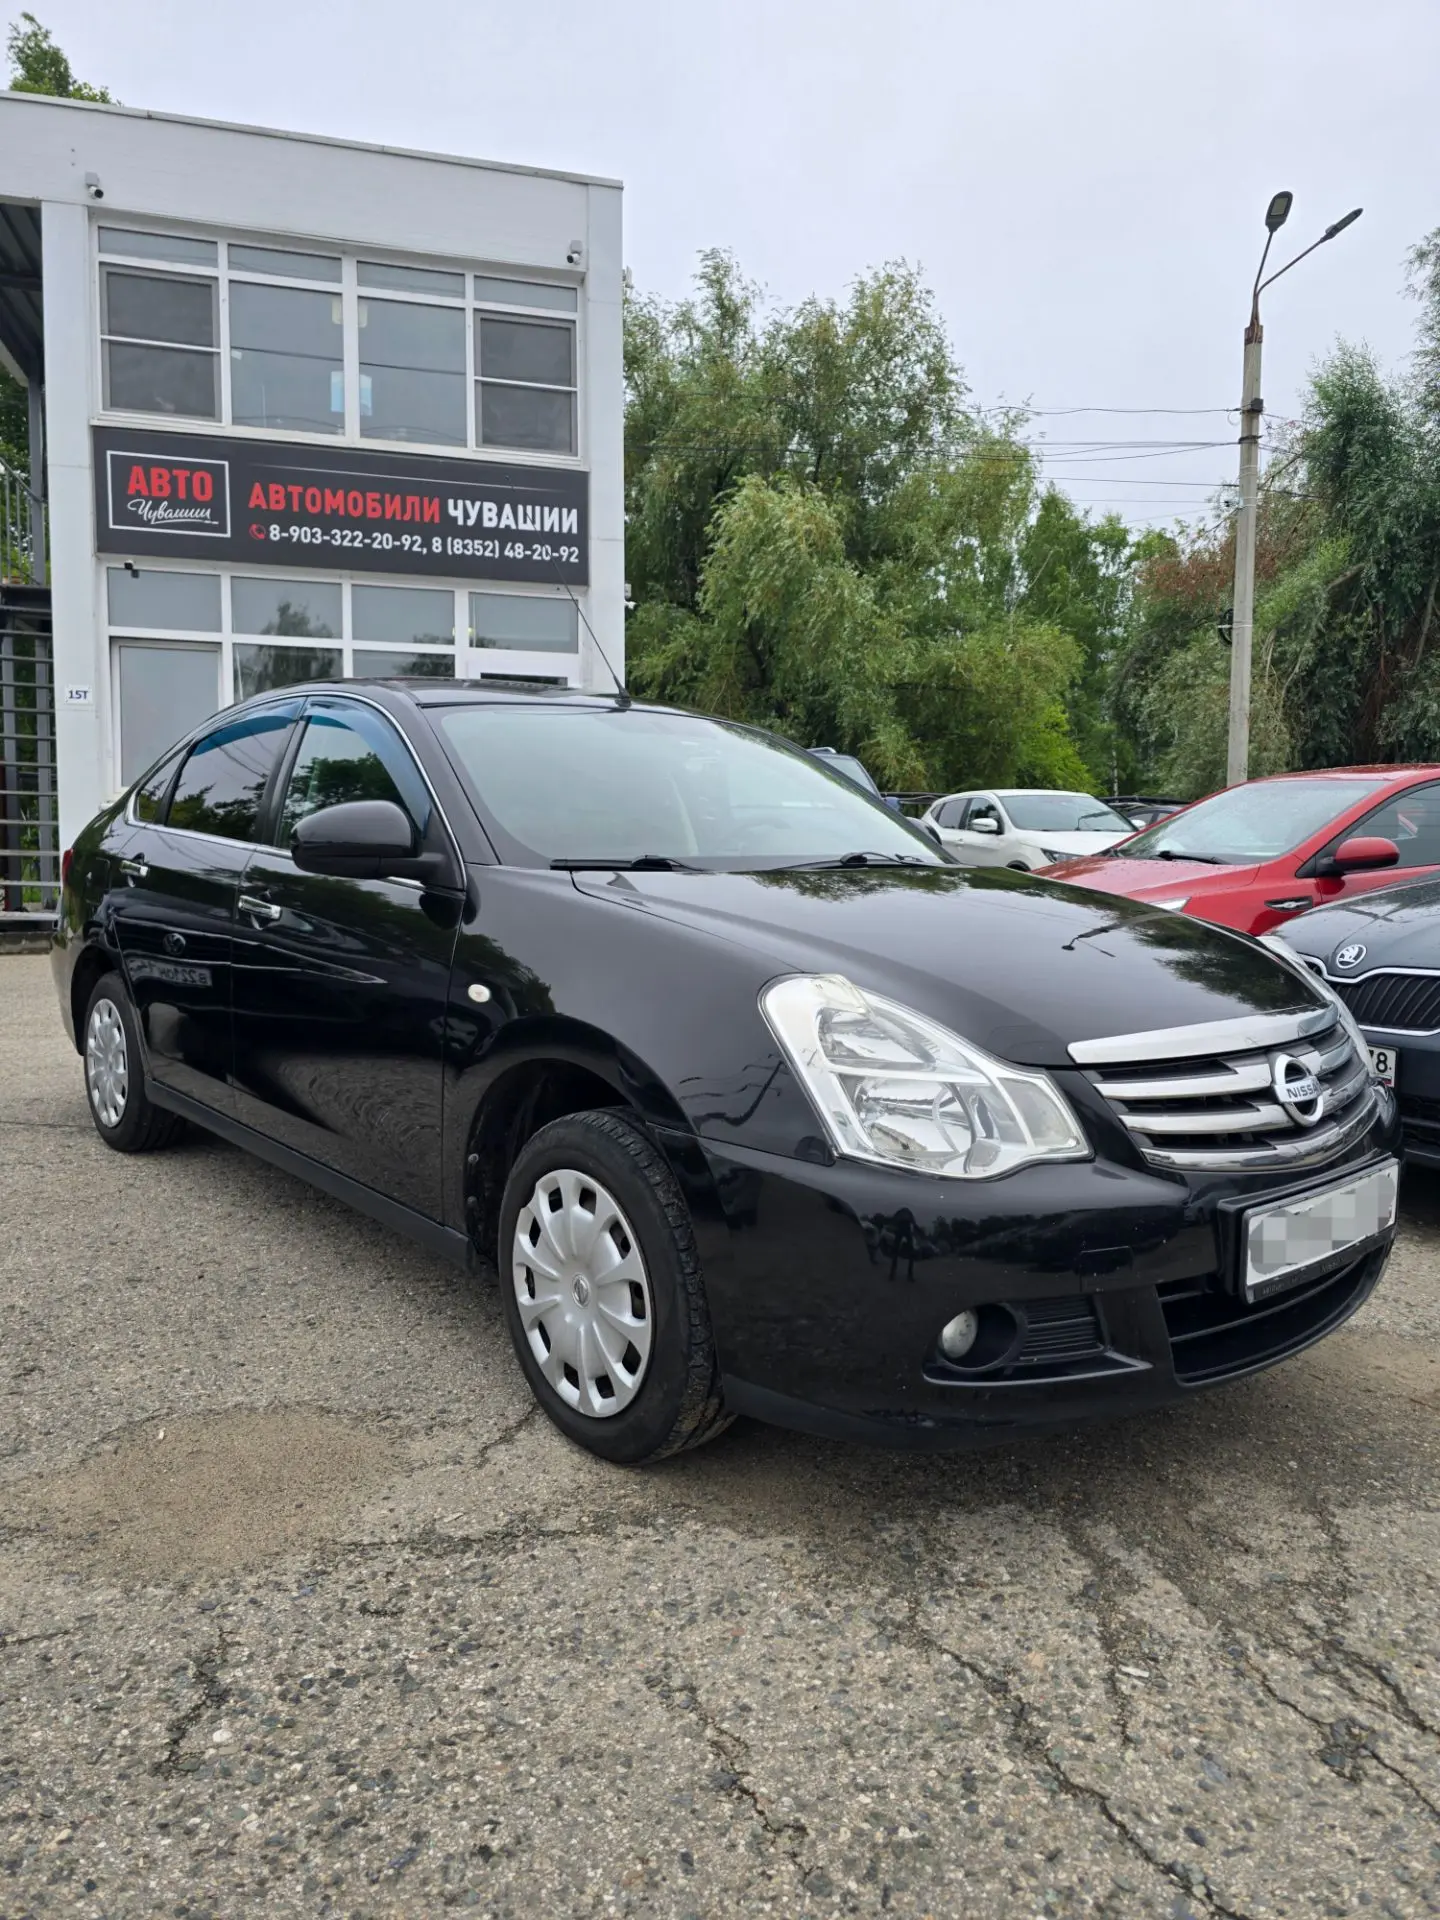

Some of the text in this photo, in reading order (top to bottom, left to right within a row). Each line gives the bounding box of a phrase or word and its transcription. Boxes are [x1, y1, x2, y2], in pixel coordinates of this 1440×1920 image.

[127, 465, 213, 502] АВТО
[127, 498, 212, 524] Чувашии
[248, 482, 578, 534] АВТОМОБИЛИ ЧУВАШИИ
[269, 524, 579, 563] 8-903-322-20-92, 8 (8352) 48-20-92
